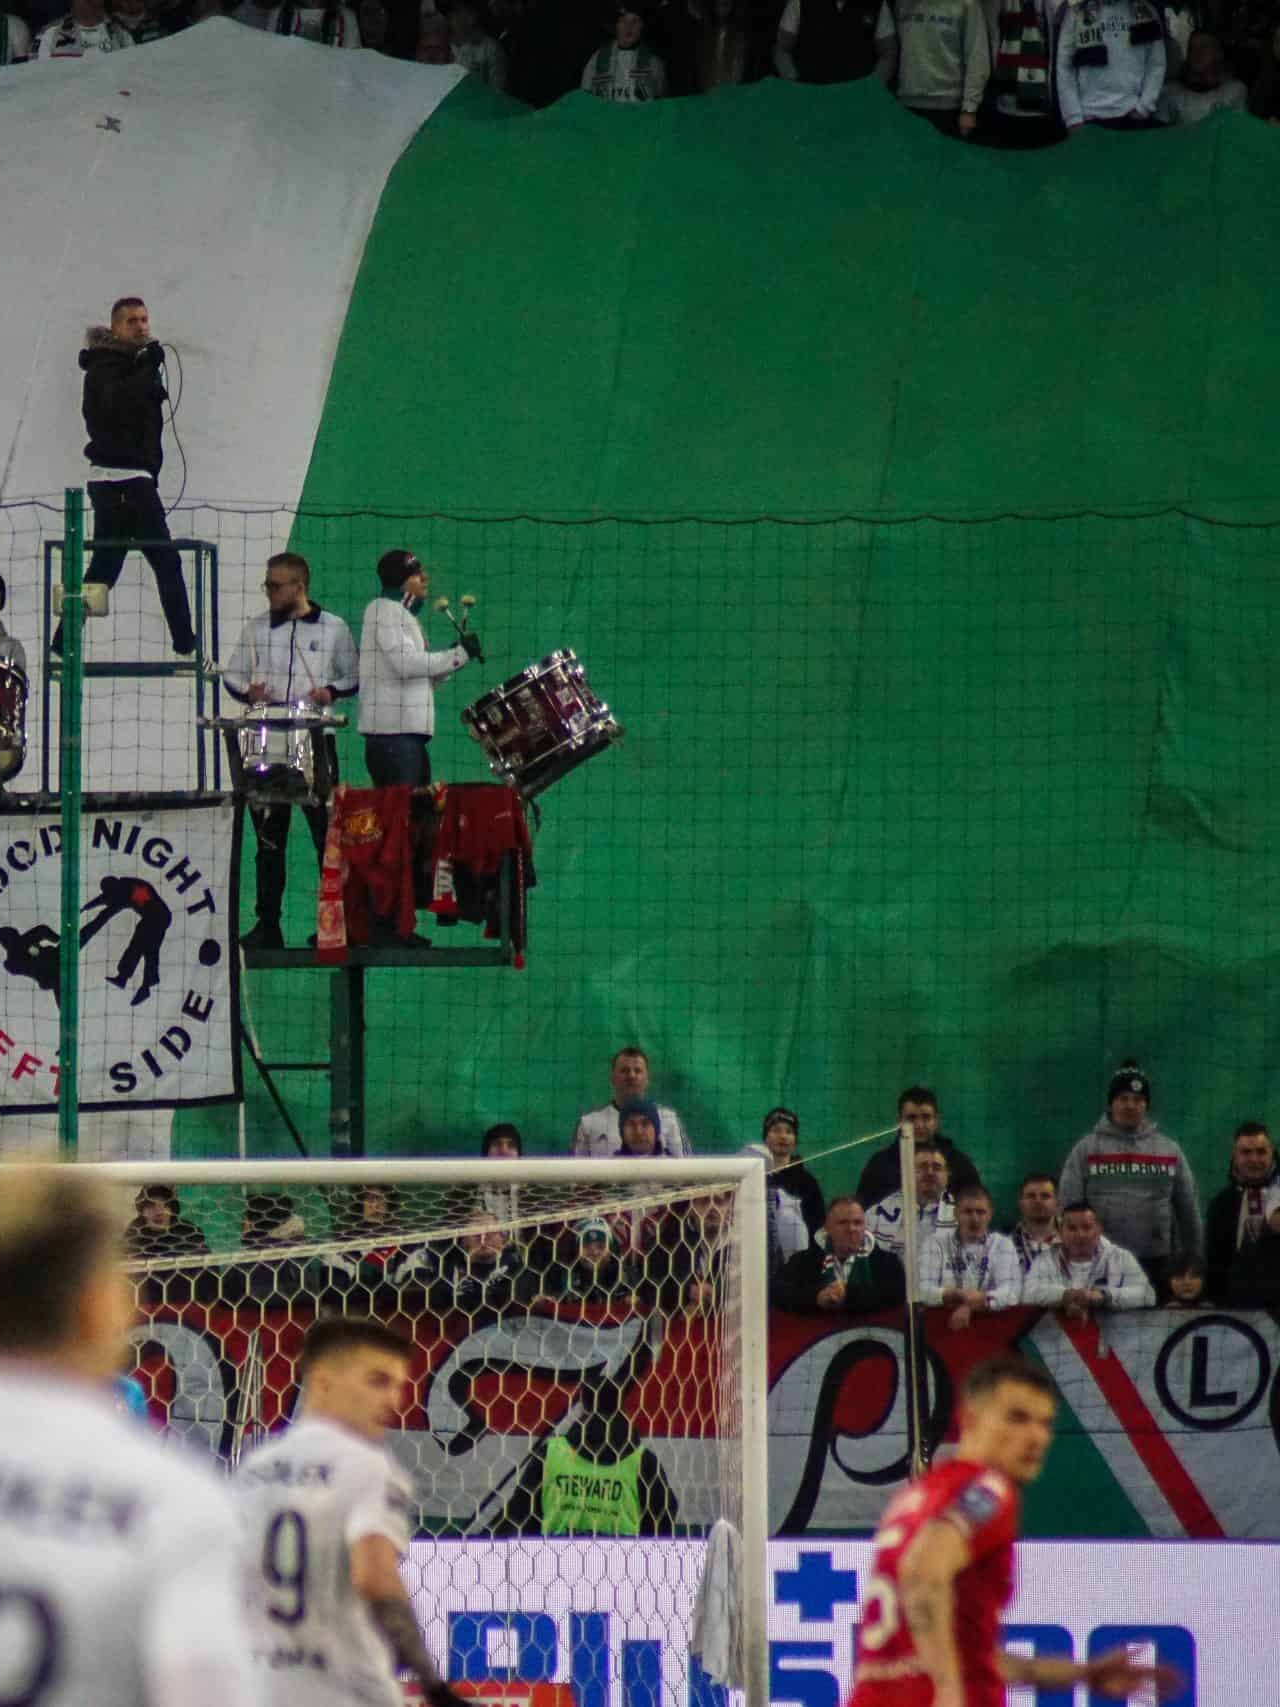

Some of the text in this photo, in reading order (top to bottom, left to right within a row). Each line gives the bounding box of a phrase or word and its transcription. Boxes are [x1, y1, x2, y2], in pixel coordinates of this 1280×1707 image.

[92, 818, 216, 917] NIGHT
[108, 989, 214, 1093] SIDE
[1190, 1336, 1238, 1409] L
[555, 1473, 624, 1502] STEWARD
[263, 1506, 310, 1629] 9
